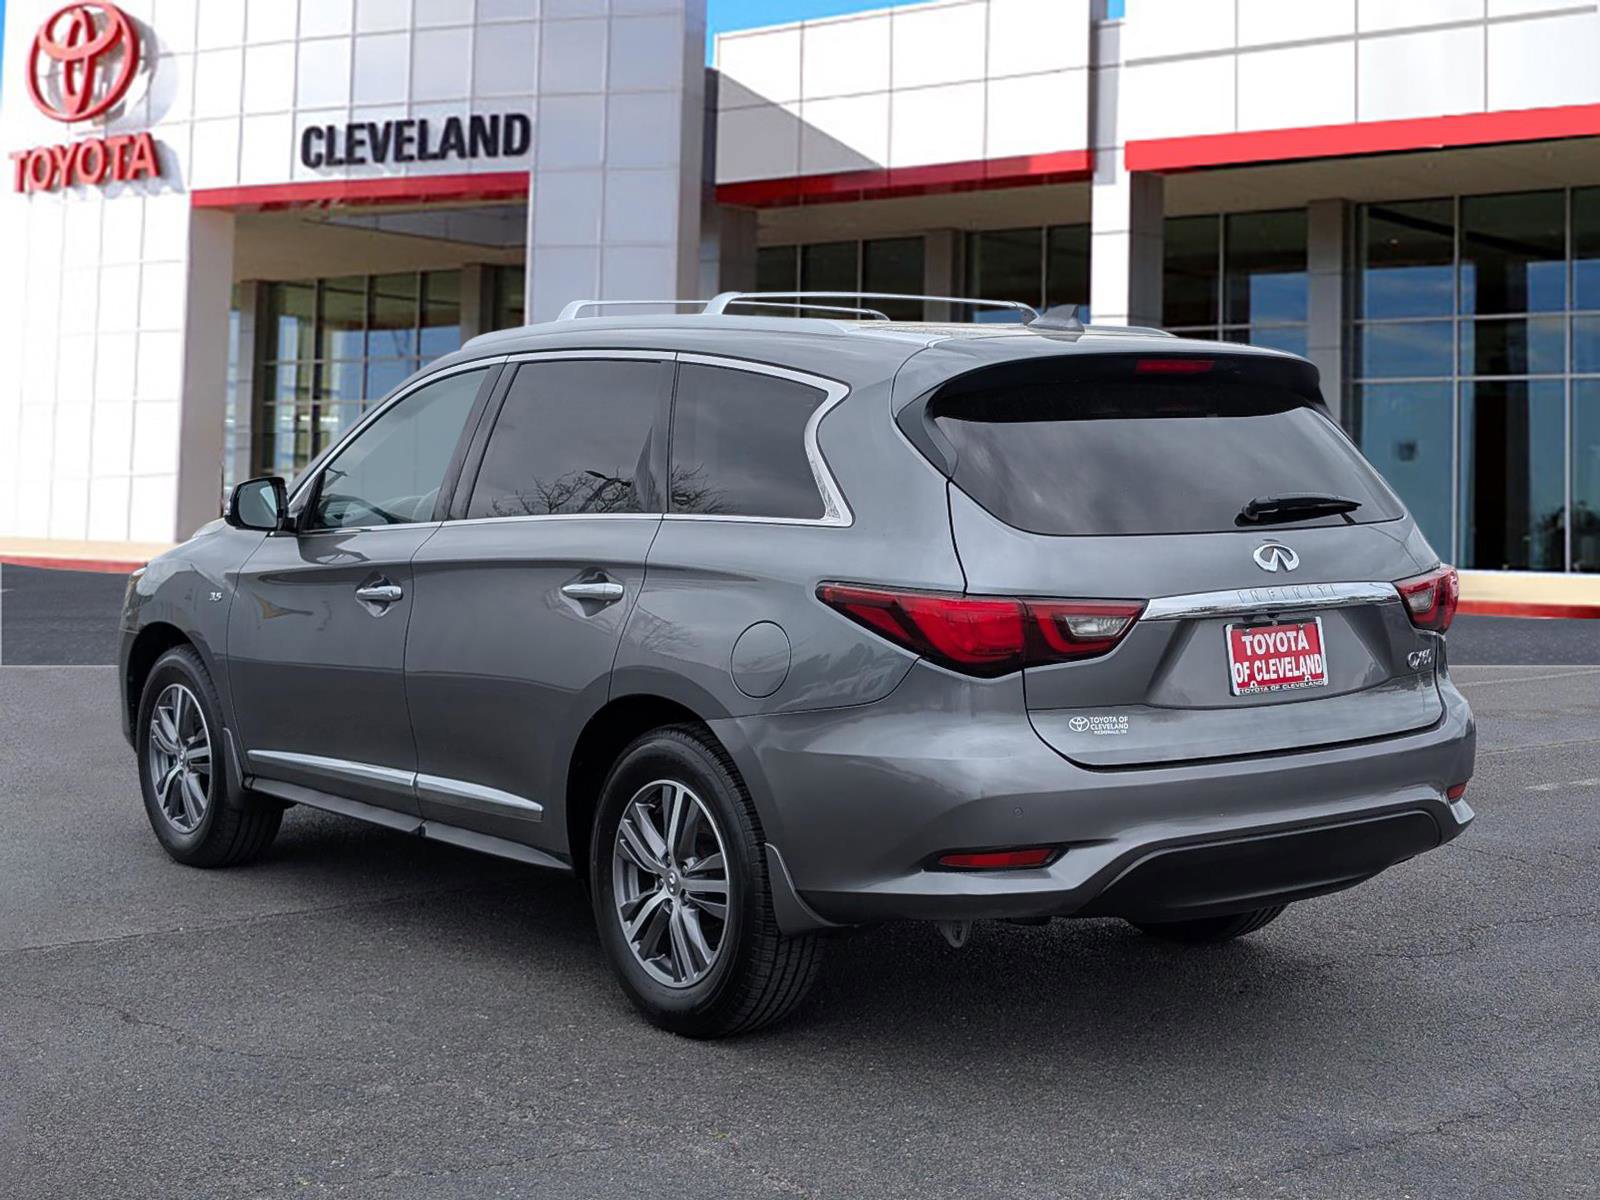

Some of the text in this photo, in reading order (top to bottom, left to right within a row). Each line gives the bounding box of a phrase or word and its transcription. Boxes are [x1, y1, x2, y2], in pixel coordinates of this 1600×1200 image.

[301, 113, 531, 169] CLEVELAND
[9, 131, 161, 194] TOYOTA
[1241, 629, 1310, 656] TOYOTA
[1234, 653, 1323, 684] OF CLEVELAND
[1240, 686, 1269, 694] TOYOTA
[1282, 680, 1324, 690] CLEVELAND
[1090, 716, 1118, 724] TOYOTA
[1090, 723, 1129, 731] CLEVELAND
